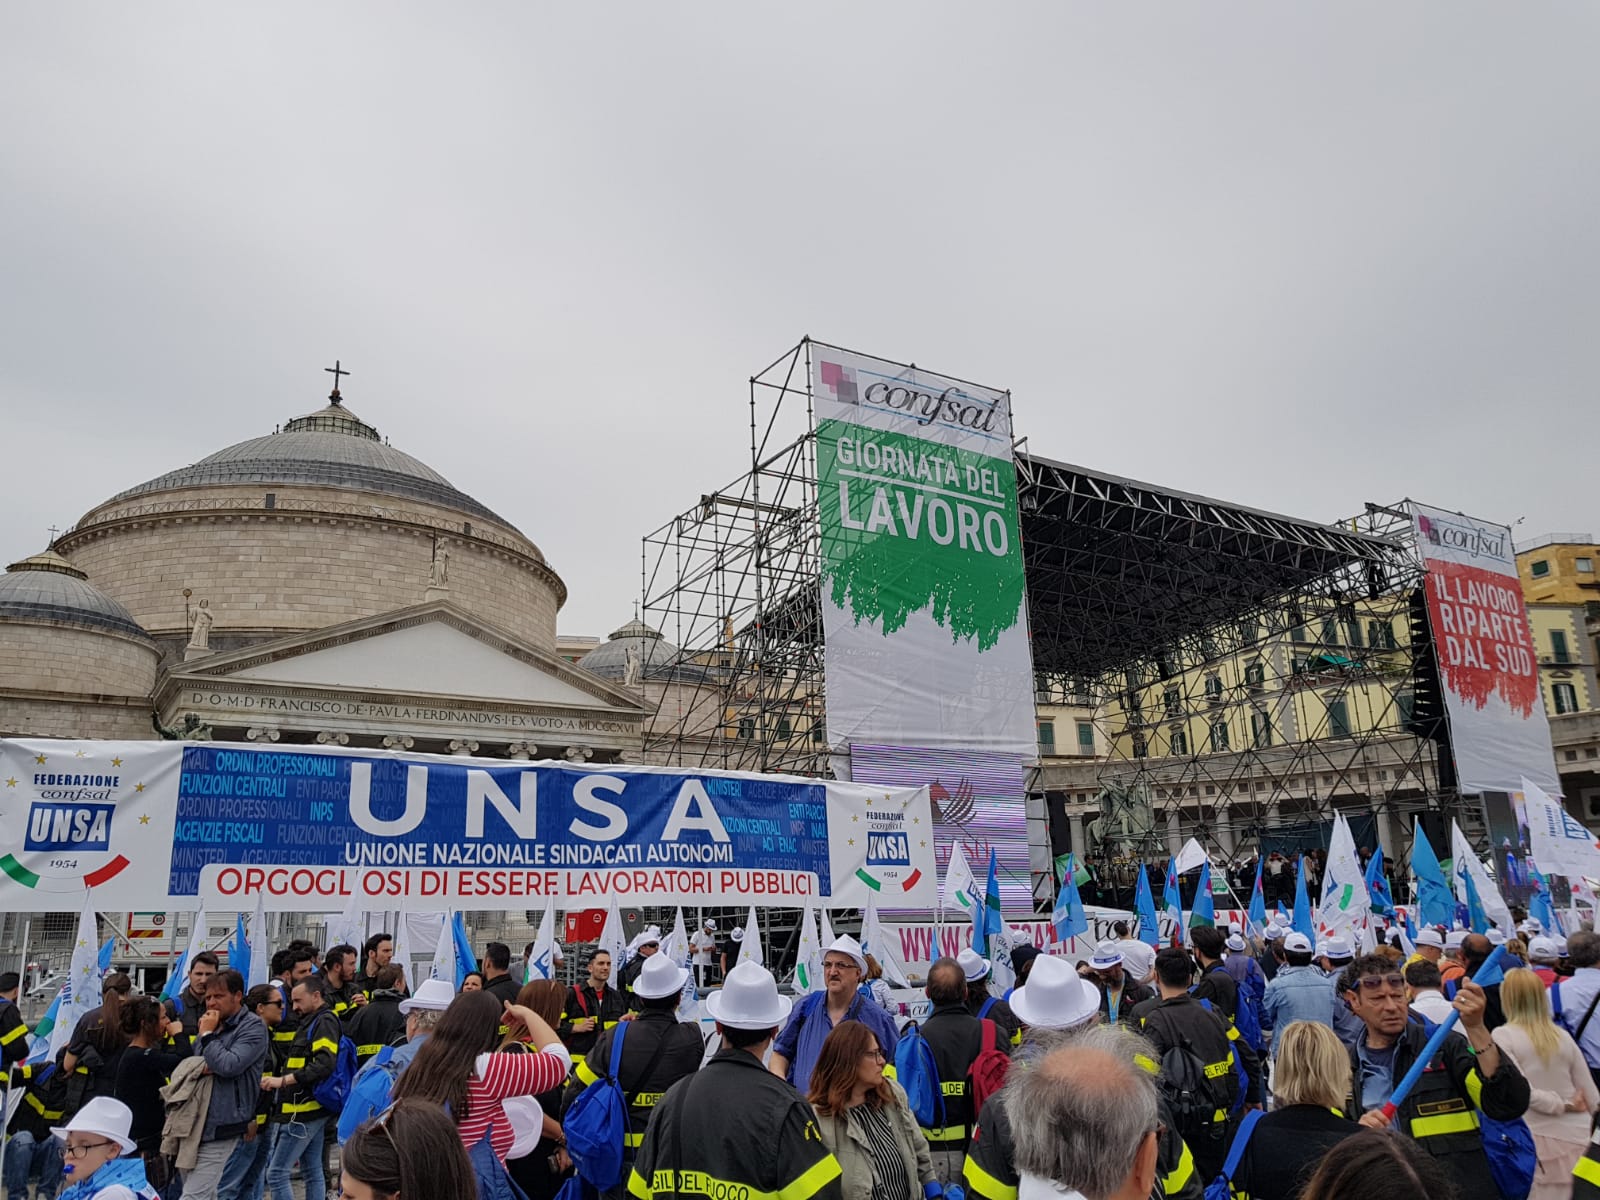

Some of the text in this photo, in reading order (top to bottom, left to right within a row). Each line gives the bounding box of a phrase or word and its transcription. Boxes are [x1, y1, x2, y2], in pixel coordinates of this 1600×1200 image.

[864, 381, 1001, 433] confsal
[837, 436, 1006, 499] GIORNATA DEL
[838, 480, 1009, 557] LAVORO
[1442, 525, 1506, 558] confsal
[1434, 573, 1519, 616] IL LAVORO
[1439, 603, 1528, 646] RIPARTE
[1446, 636, 1533, 678] DAL SUD
[215, 752, 254, 773] ORDINI
[255, 753, 337, 777] PROFESSIONALI
[34, 773, 120, 788] FEDERAZIONE
[180, 773, 233, 796] FUNZIONI
[235, 775, 287, 798] CENTRALI
[41, 788, 113, 802] confsal
[178, 796, 215, 818] ORDINI
[309, 801, 334, 822] INPS
[349, 762, 731, 842] UNSA
[30, 807, 109, 843] UNSA
[174, 820, 222, 843] AGENZIE
[224, 822, 265, 844] FISCALI
[747, 818, 782, 836] CENTRALI
[345, 842, 428, 865] UNIONE
[432, 842, 546, 865] NAZIONALE
[549, 843, 643, 865] SINDACATI
[647, 843, 734, 864] AUTONOMI
[868, 835, 908, 860] UNSA
[50, 859, 79, 869] 1954
[216, 867, 410, 897] ORGOGLOSI
[421, 870, 449, 897] DI
[458, 871, 559, 897] ESSERE
[566, 870, 713, 896] LAVORATORI
[720, 871, 812, 896] PUBBLICI
